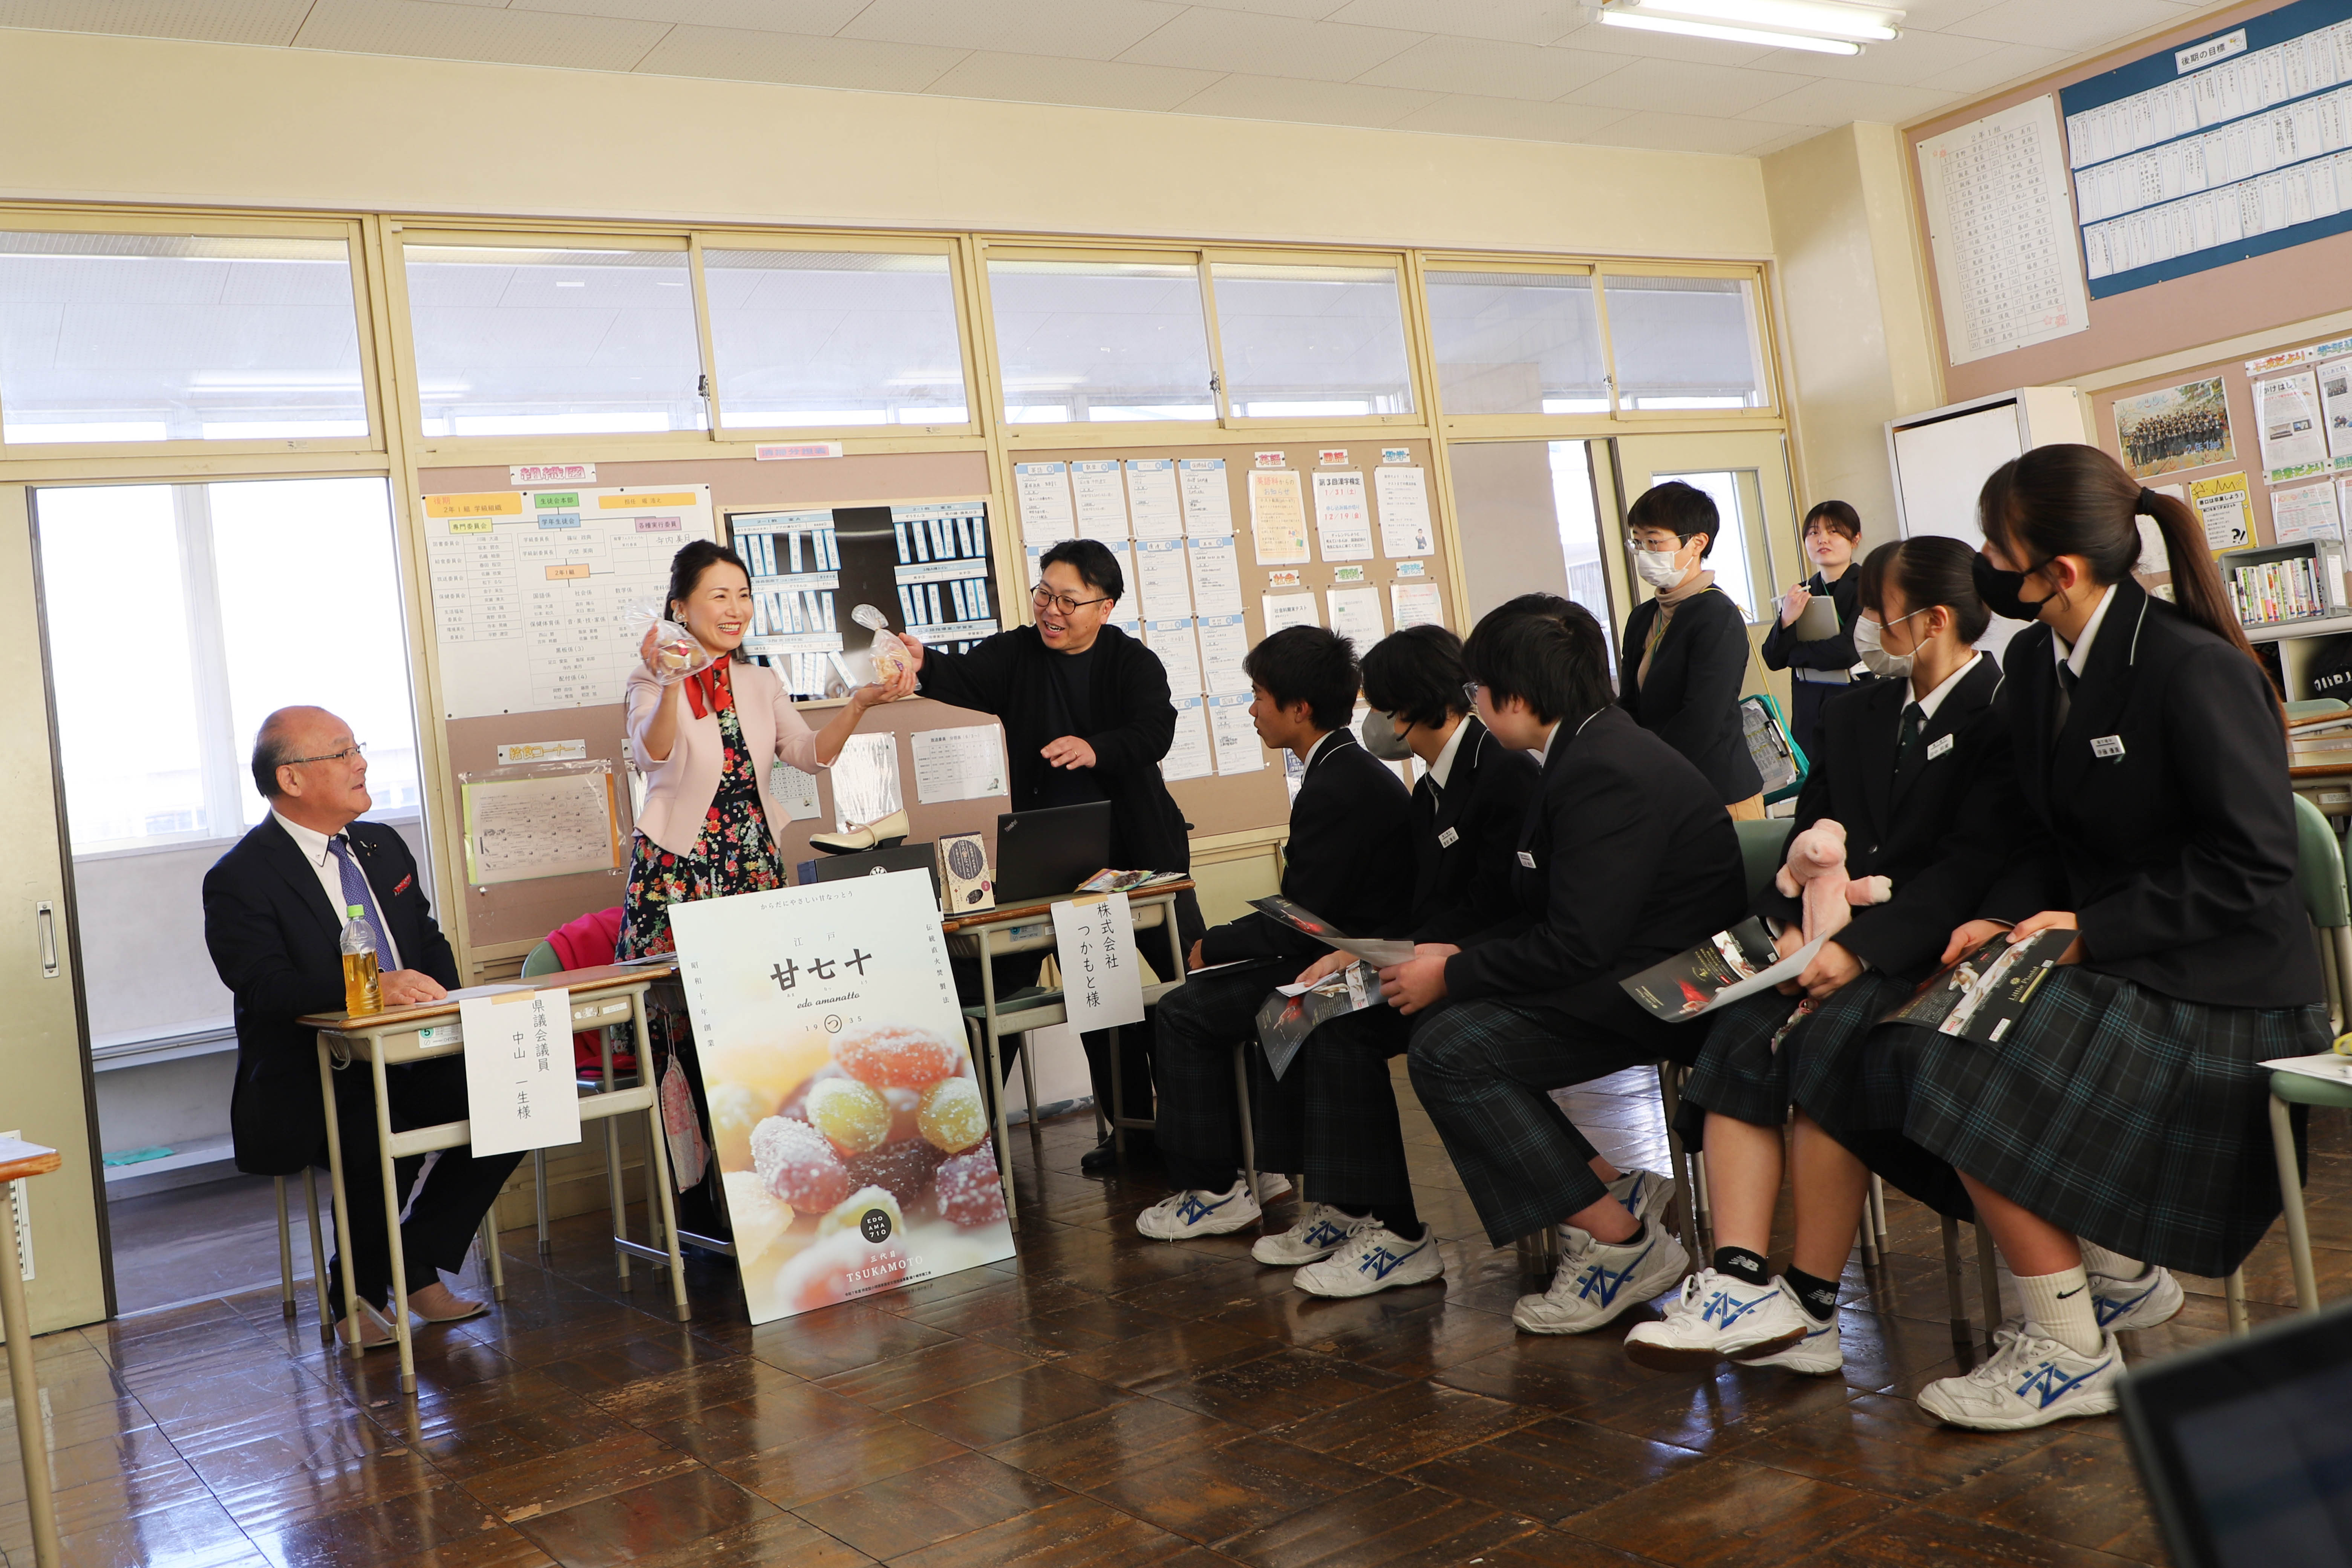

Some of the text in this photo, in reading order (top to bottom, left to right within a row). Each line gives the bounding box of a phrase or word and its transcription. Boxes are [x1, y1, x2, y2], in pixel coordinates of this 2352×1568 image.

[2181, 43, 2225, 66] 後期の目標
[1259, 454, 1281, 465] 英語
[1323, 452, 1345, 463] 国語
[1386, 451, 1406, 461] 数学
[520, 466, 585, 481] 組織図
[2272, 461, 2324, 482] 図書だより
[1257, 477, 1294, 485] 英語科からの
[1319, 478, 1360, 486] 第3回漢字検定
[1338, 568, 1359, 580] 理科
[1400, 564, 1421, 575] 音楽
[1273, 573, 1295, 585] 社会
[509, 744, 576, 760] 給食コーナー
[760, 890, 853, 910] からだにやさしい甘なっとう
[1097, 902, 1119, 969] 株式会社
[770, 948, 872, 991] 甘七十
[926, 923, 949, 1004] 伝統直火焚製法
[1078, 926, 1101, 1008] つかもと様
[2008, 966, 2039, 1000] Little Pianist
[691, 961, 714, 1047] 昭和十年創業
[797, 991, 860, 1009] edo amanatto
[531, 1000, 550, 1072] 県議会議員
[513, 1031, 531, 1119] 中山 一生様
[867, 1216, 883, 1224] EDO
[868, 1223, 885, 1231] AMA
[870, 1229, 886, 1238] 710
[870, 1250, 896, 1263] 三代目
[846, 1256, 923, 1282] TSUKAMOTO
